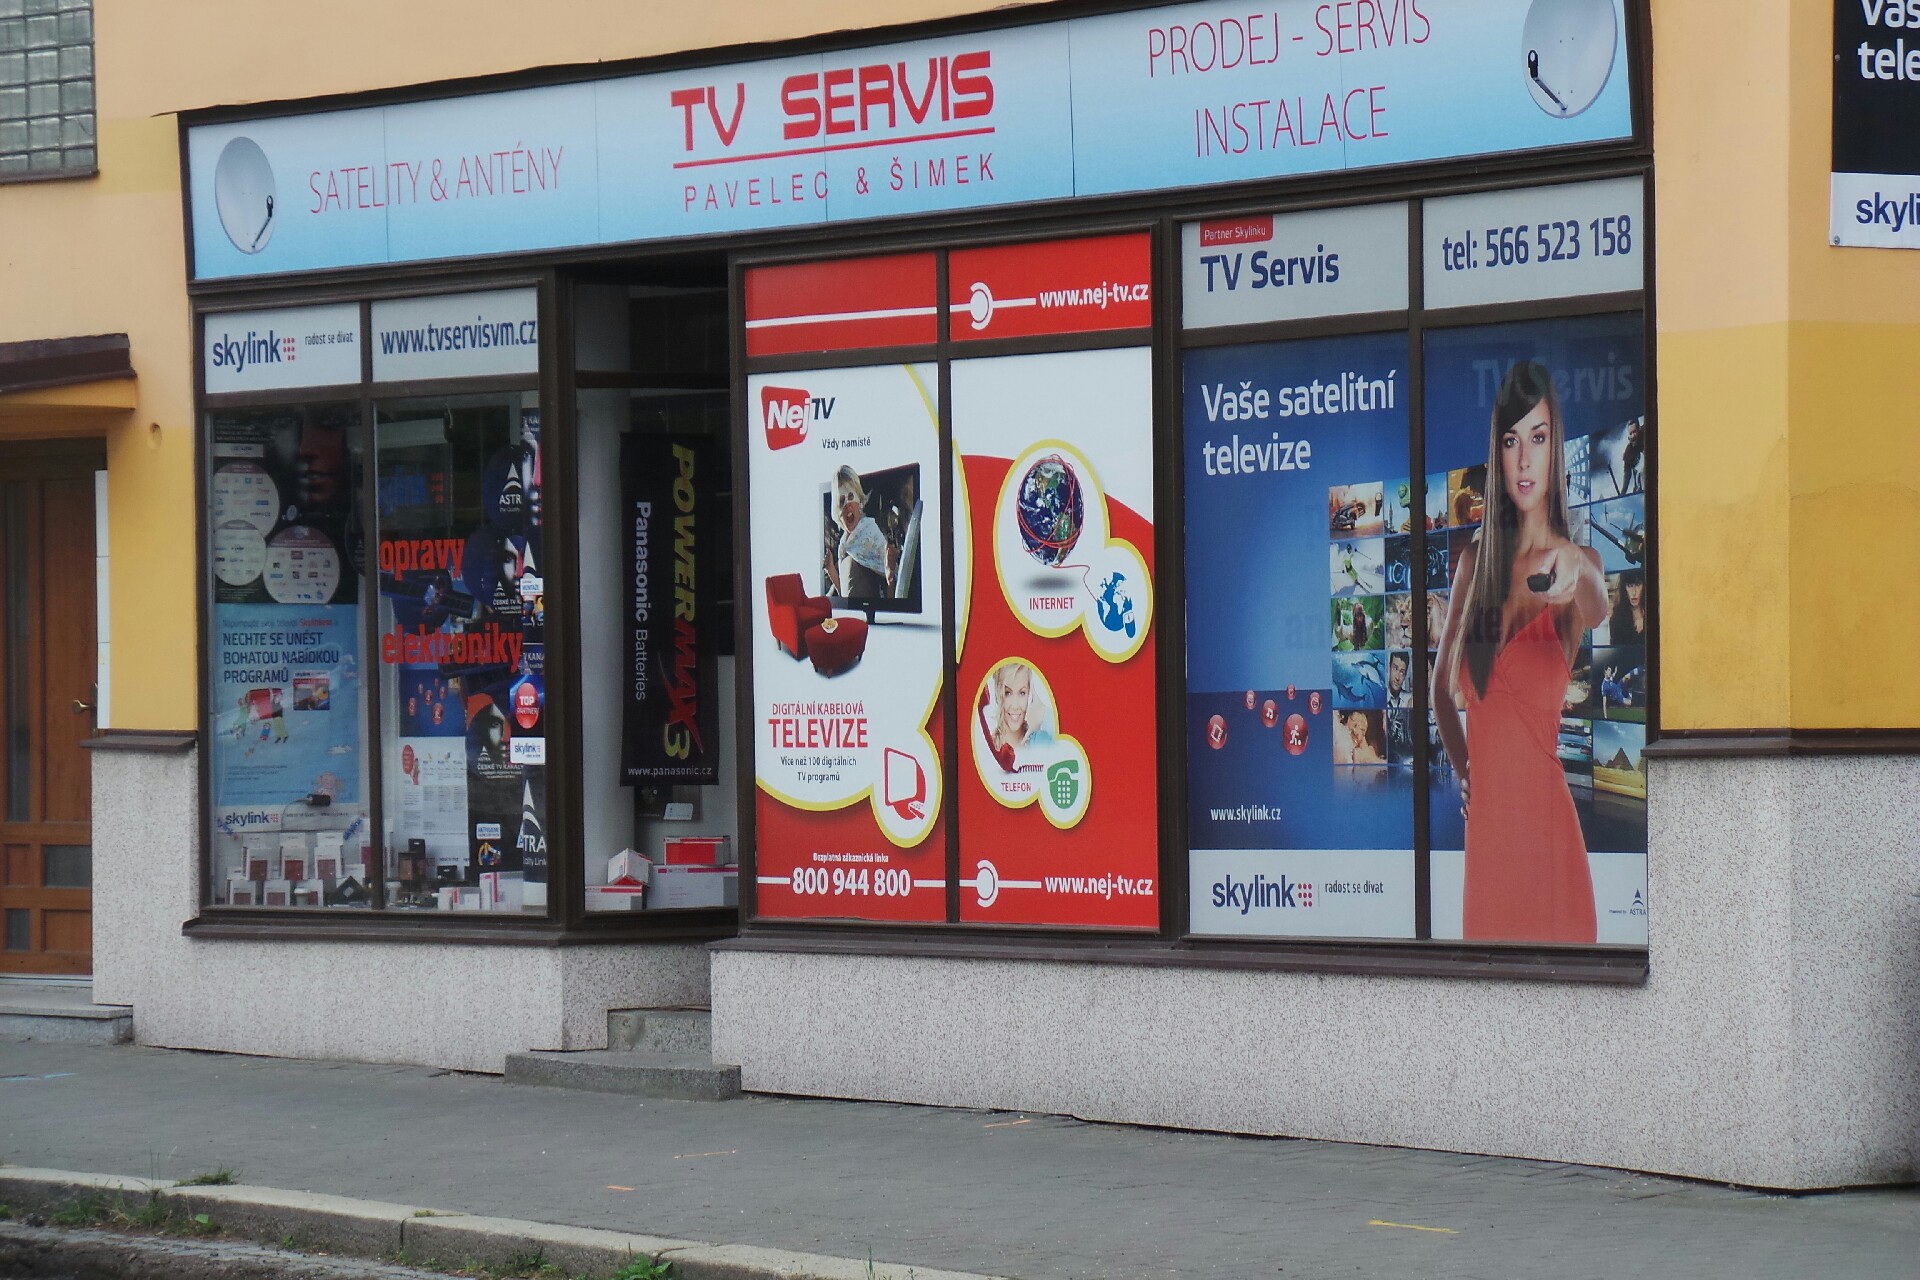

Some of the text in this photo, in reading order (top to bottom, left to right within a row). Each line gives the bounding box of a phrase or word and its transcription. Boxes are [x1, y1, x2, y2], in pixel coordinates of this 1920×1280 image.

[1148, 12, 1280, 79] PRODEJ
[1316, 0, 1431, 57] SERVIS
[1857, 39, 1920, 81] tele
[670, 50, 994, 151] TV SERVIS
[1196, 86, 1389, 157] INSTALACE
[309, 140, 563, 214] SATELITY & ANTÉNY
[684, 152, 995, 213] PAVELEC & ŠIMEK
[1204, 223, 1267, 241] Partner Skylinku
[1442, 214, 1633, 271] tel: 566 523 158
[1200, 244, 1340, 293] TV Servis
[1039, 282, 1149, 310] www.nej-tv.cz
[380, 315, 538, 355] www.tvservisvm.cz
[212, 329, 282, 373] skylink
[304, 332, 327, 346] radost
[327, 334, 336, 345] se
[1201, 369, 1398, 422] Vaše satelitní
[1202, 432, 1312, 476] televize
[379, 538, 465, 581] opravy
[636, 501, 651, 622] Panasonic
[1029, 596, 1074, 611] INTERNET
[222, 630, 323, 646] NECHTE SE UNÉST
[381, 622, 523, 673] elektroniky
[223, 648, 339, 664] BOHATOU NABÍDKOU
[635, 629, 648, 701] Batteries
[223, 667, 289, 683] PROGRAMŮ
[519, 695, 535, 706] TOP
[772, 700, 864, 715] DIGITÁLNÍ KABELOVÁ
[768, 718, 868, 748] TELEVIZE
[514, 742, 537, 755] skylink
[795, 755, 807, 766] než
[809, 756, 821, 766] 100
[627, 766, 712, 777] www.panasonic.cz
[797, 771, 806, 781] TV
[1001, 782, 1032, 792] TELEFON
[225, 811, 270, 827] skylink
[1210, 804, 1281, 824] www.skylink.cz
[793, 867, 911, 897] 800 944 800
[1044, 872, 1153, 900] www.nej-tv.cz
[1212, 874, 1296, 915] skylink
[1324, 880, 1350, 894] radost
[1352, 883, 1361, 894] se
